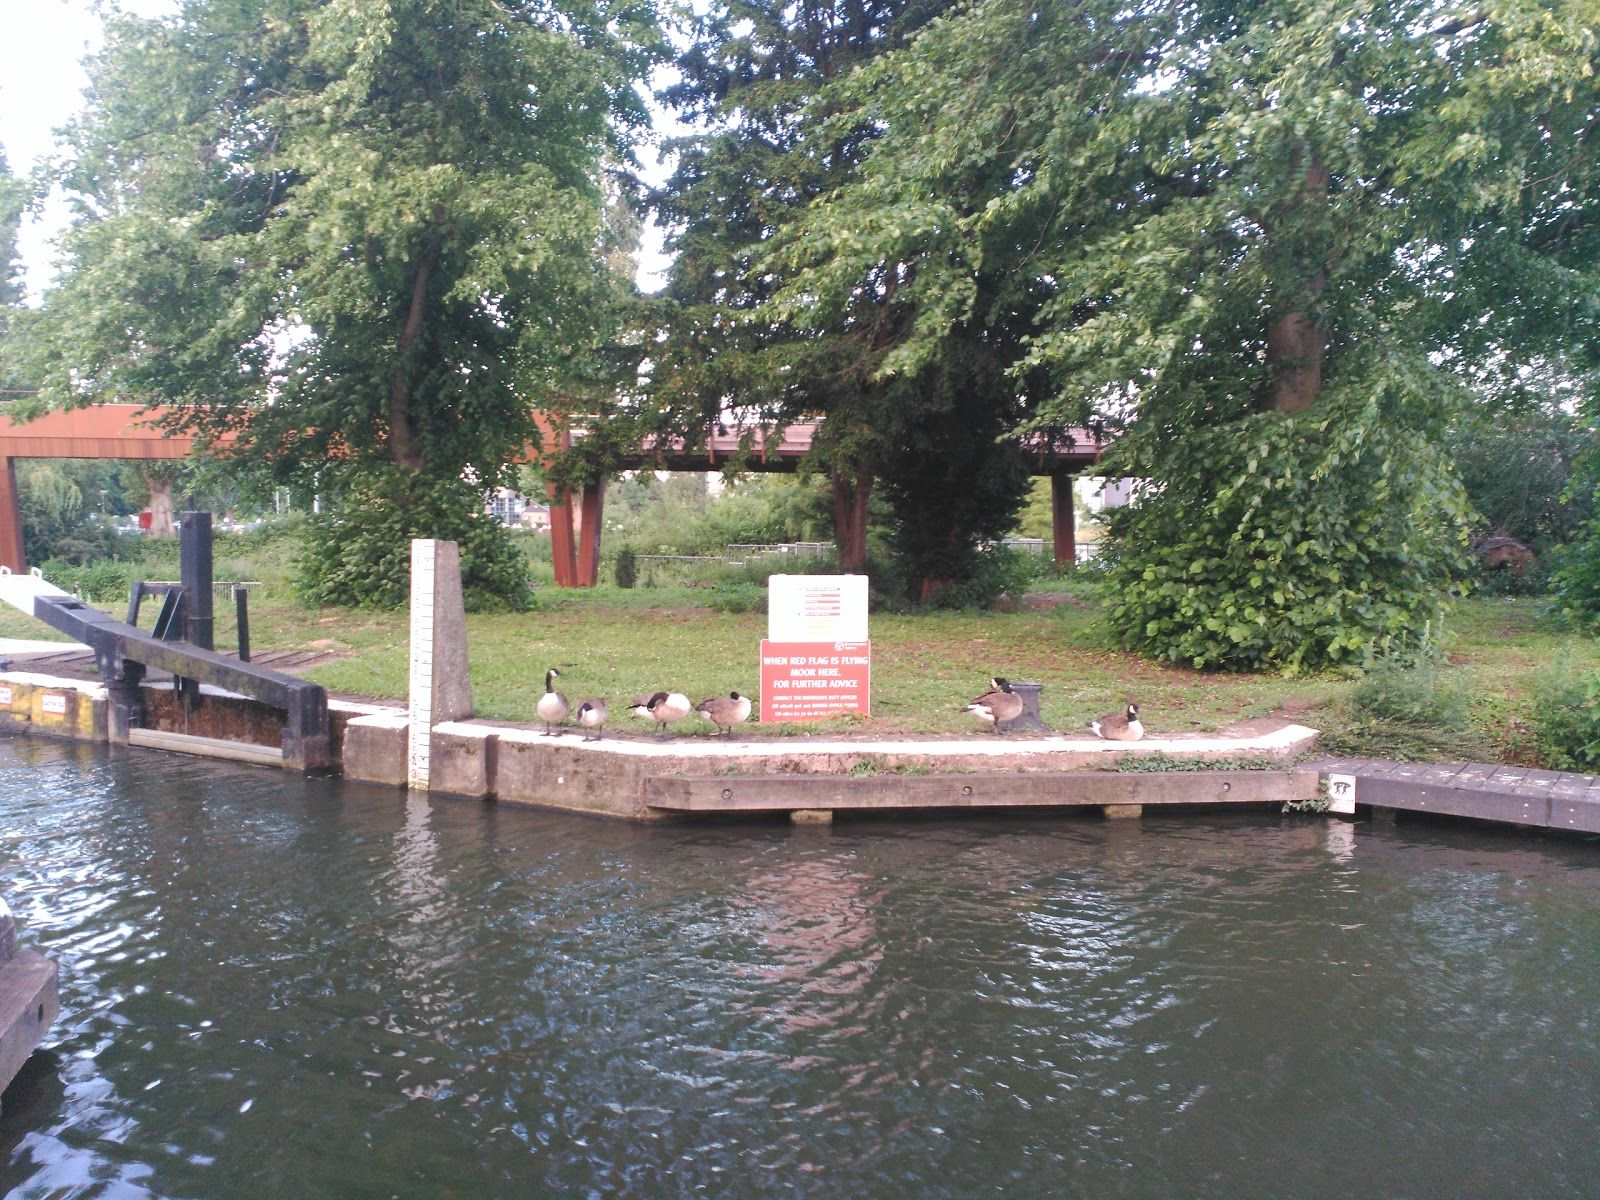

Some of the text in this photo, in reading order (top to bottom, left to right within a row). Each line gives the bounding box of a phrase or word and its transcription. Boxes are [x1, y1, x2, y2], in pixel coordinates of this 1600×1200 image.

[763, 656, 869, 665] WHEN RED FLAG IS FLYING
[790, 668, 841, 676] MOOR HERE.
[773, 680, 859, 688] FOR FURTHER ADVICE
